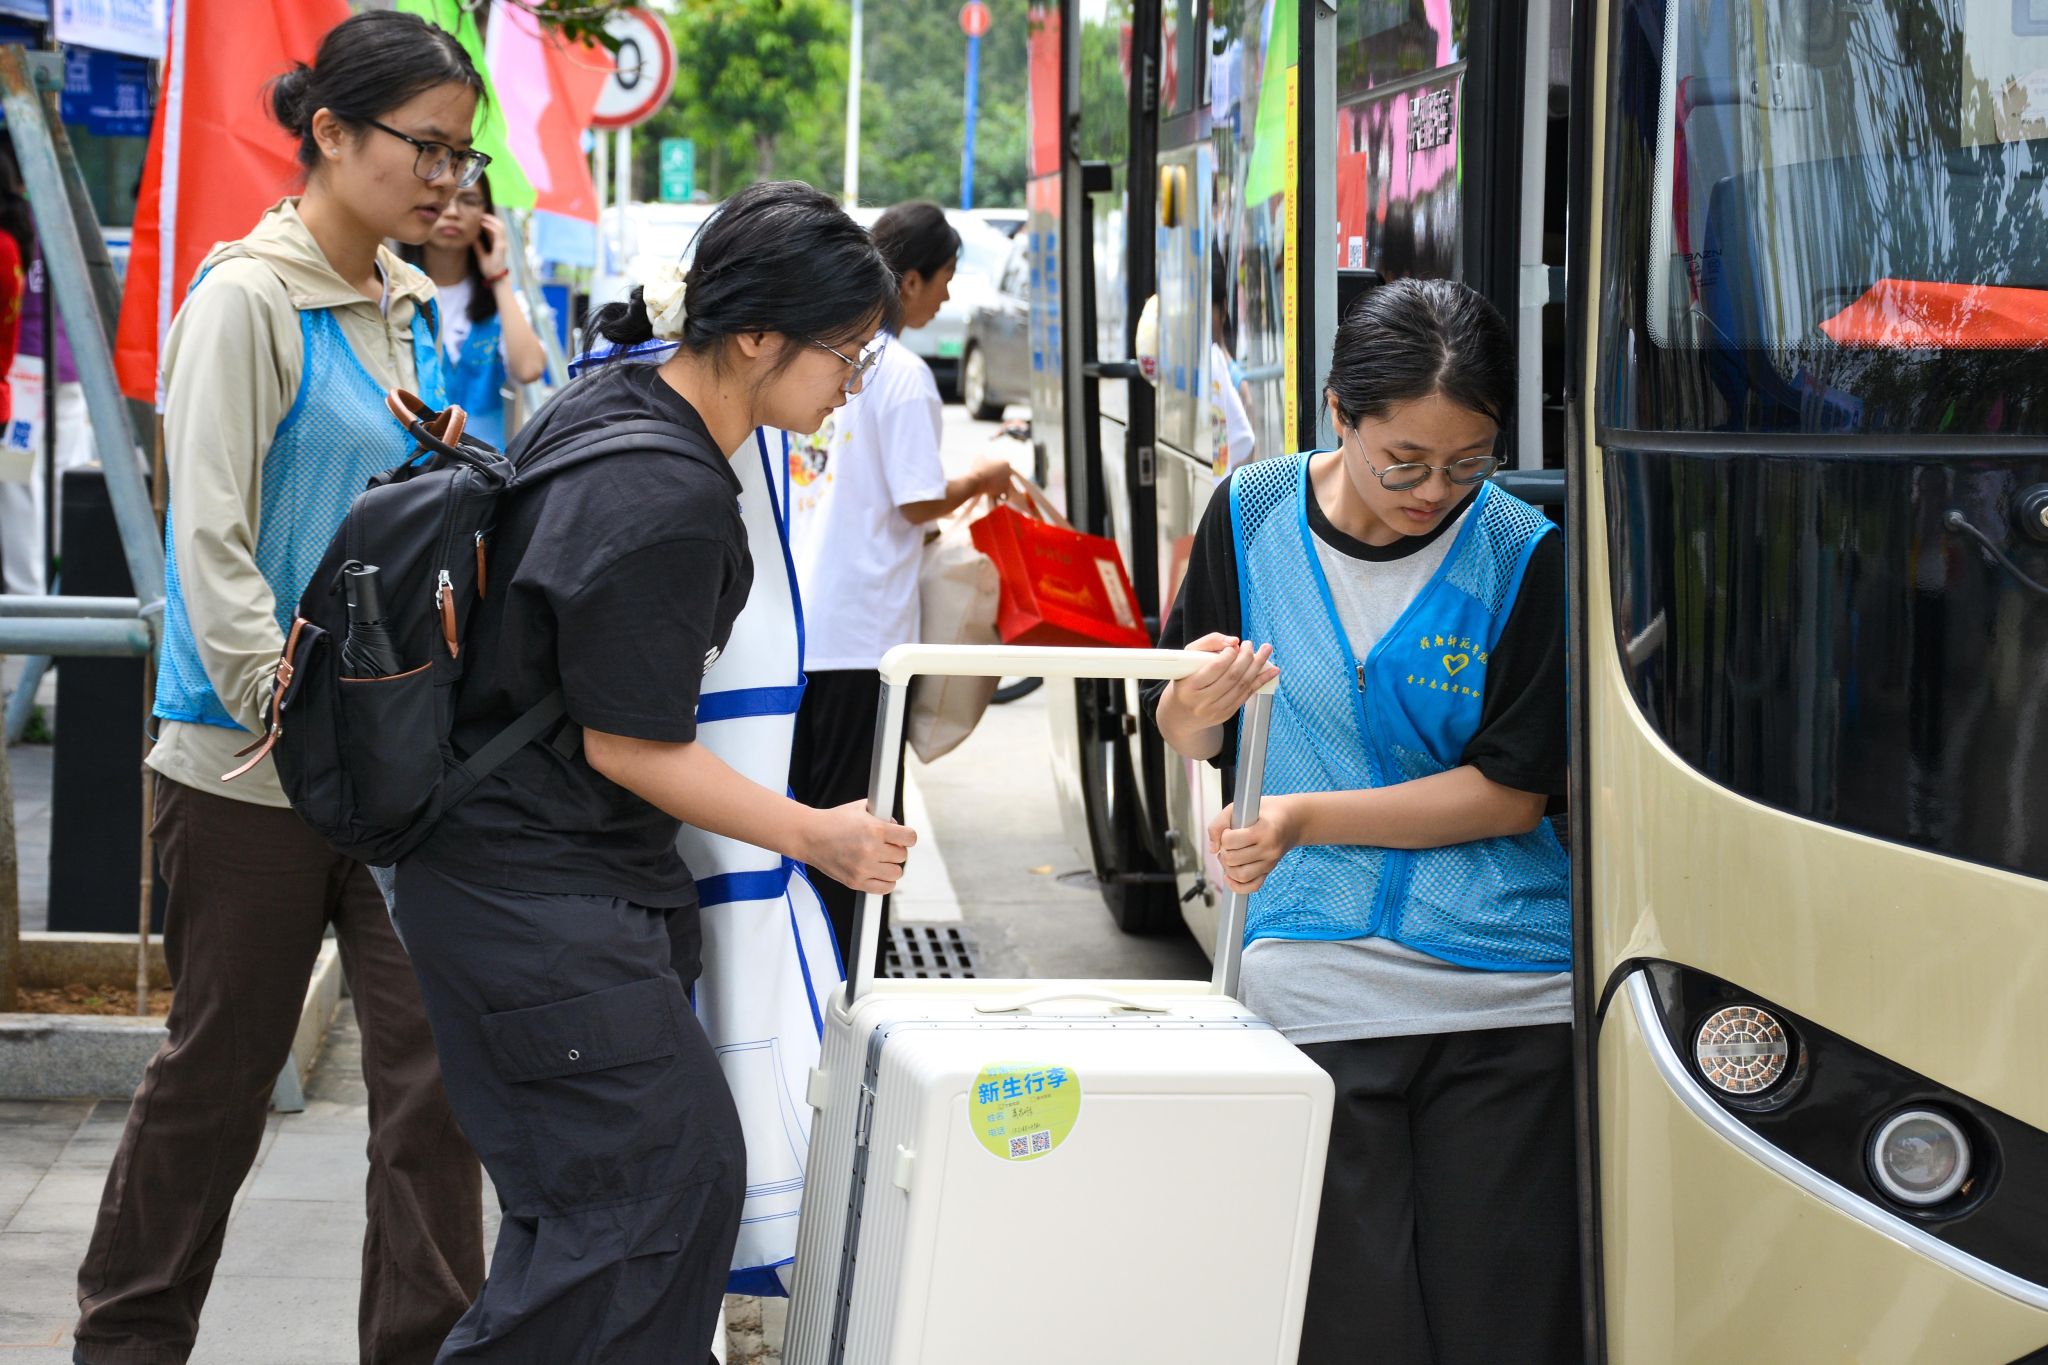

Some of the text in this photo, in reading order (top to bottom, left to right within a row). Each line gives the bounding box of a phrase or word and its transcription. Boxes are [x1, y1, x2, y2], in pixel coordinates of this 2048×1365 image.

[616, 37, 642, 90] 0
[978, 1067, 1068, 1105] 新生行李
